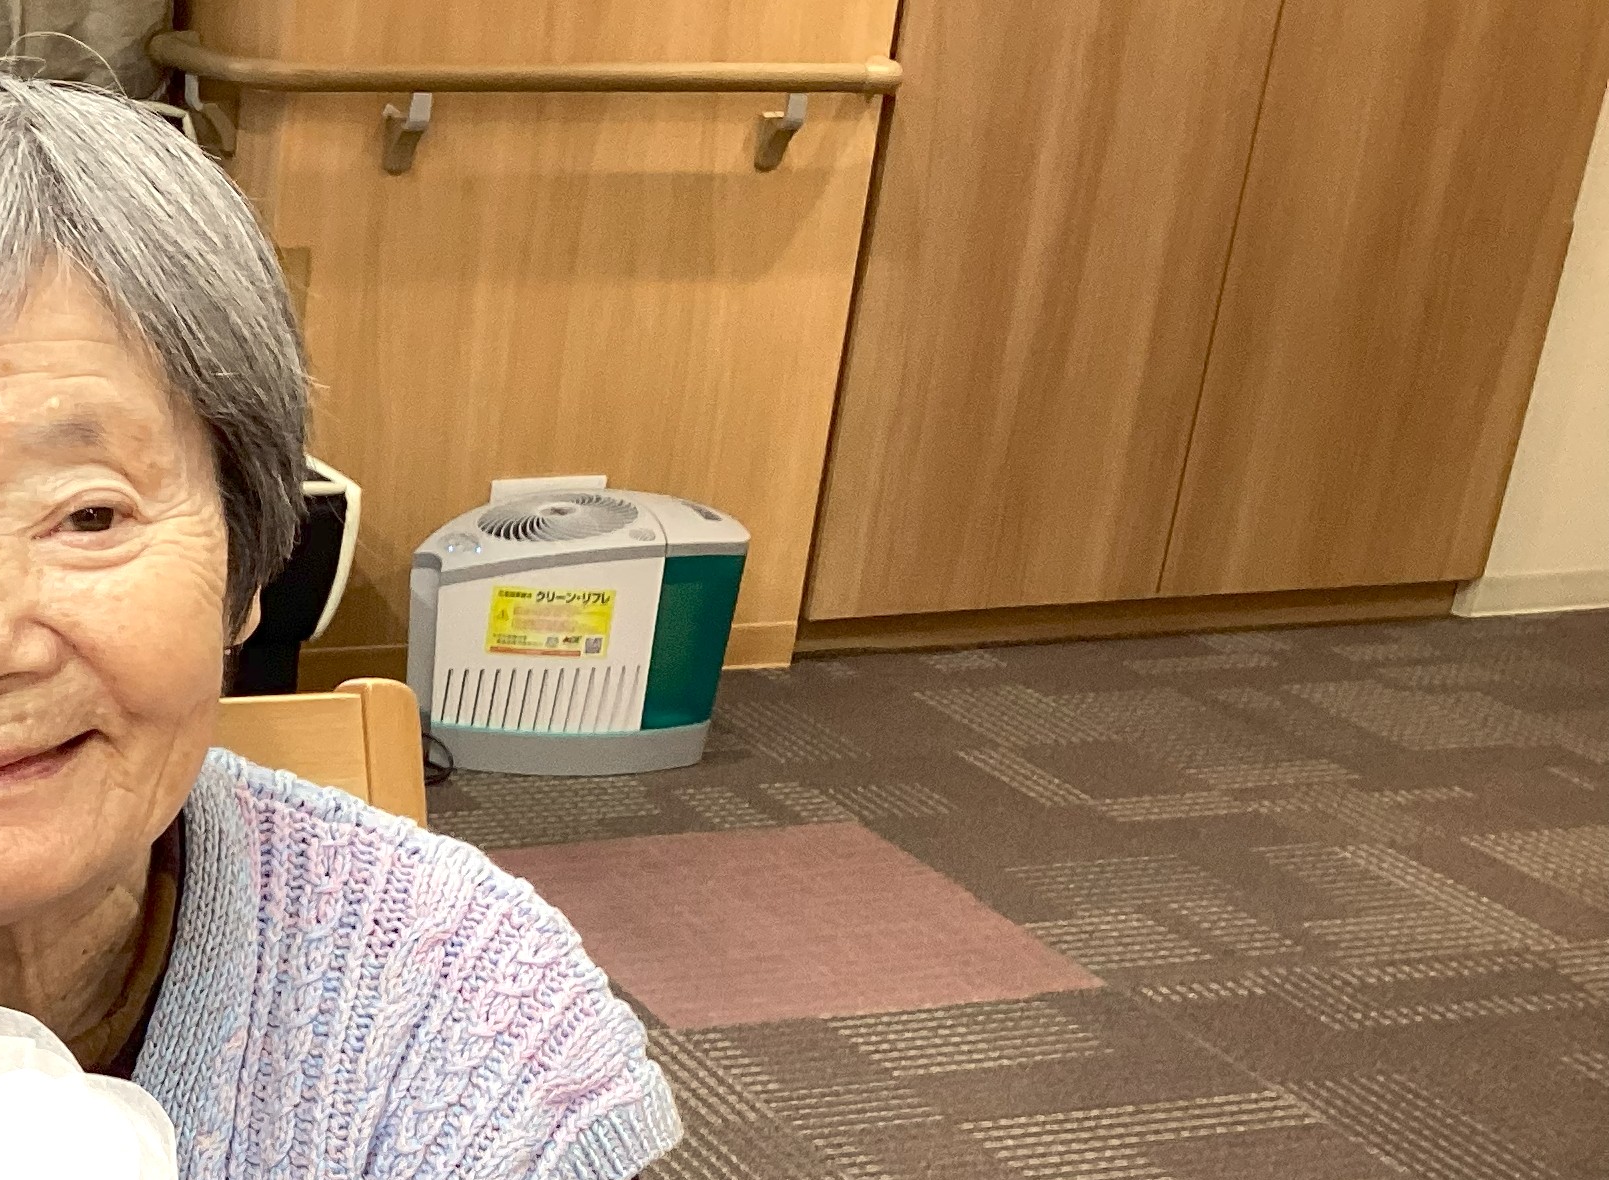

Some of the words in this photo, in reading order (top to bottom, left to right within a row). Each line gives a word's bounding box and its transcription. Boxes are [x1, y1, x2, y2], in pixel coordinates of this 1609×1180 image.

[536, 590, 611, 604] クリーン・リフレ
